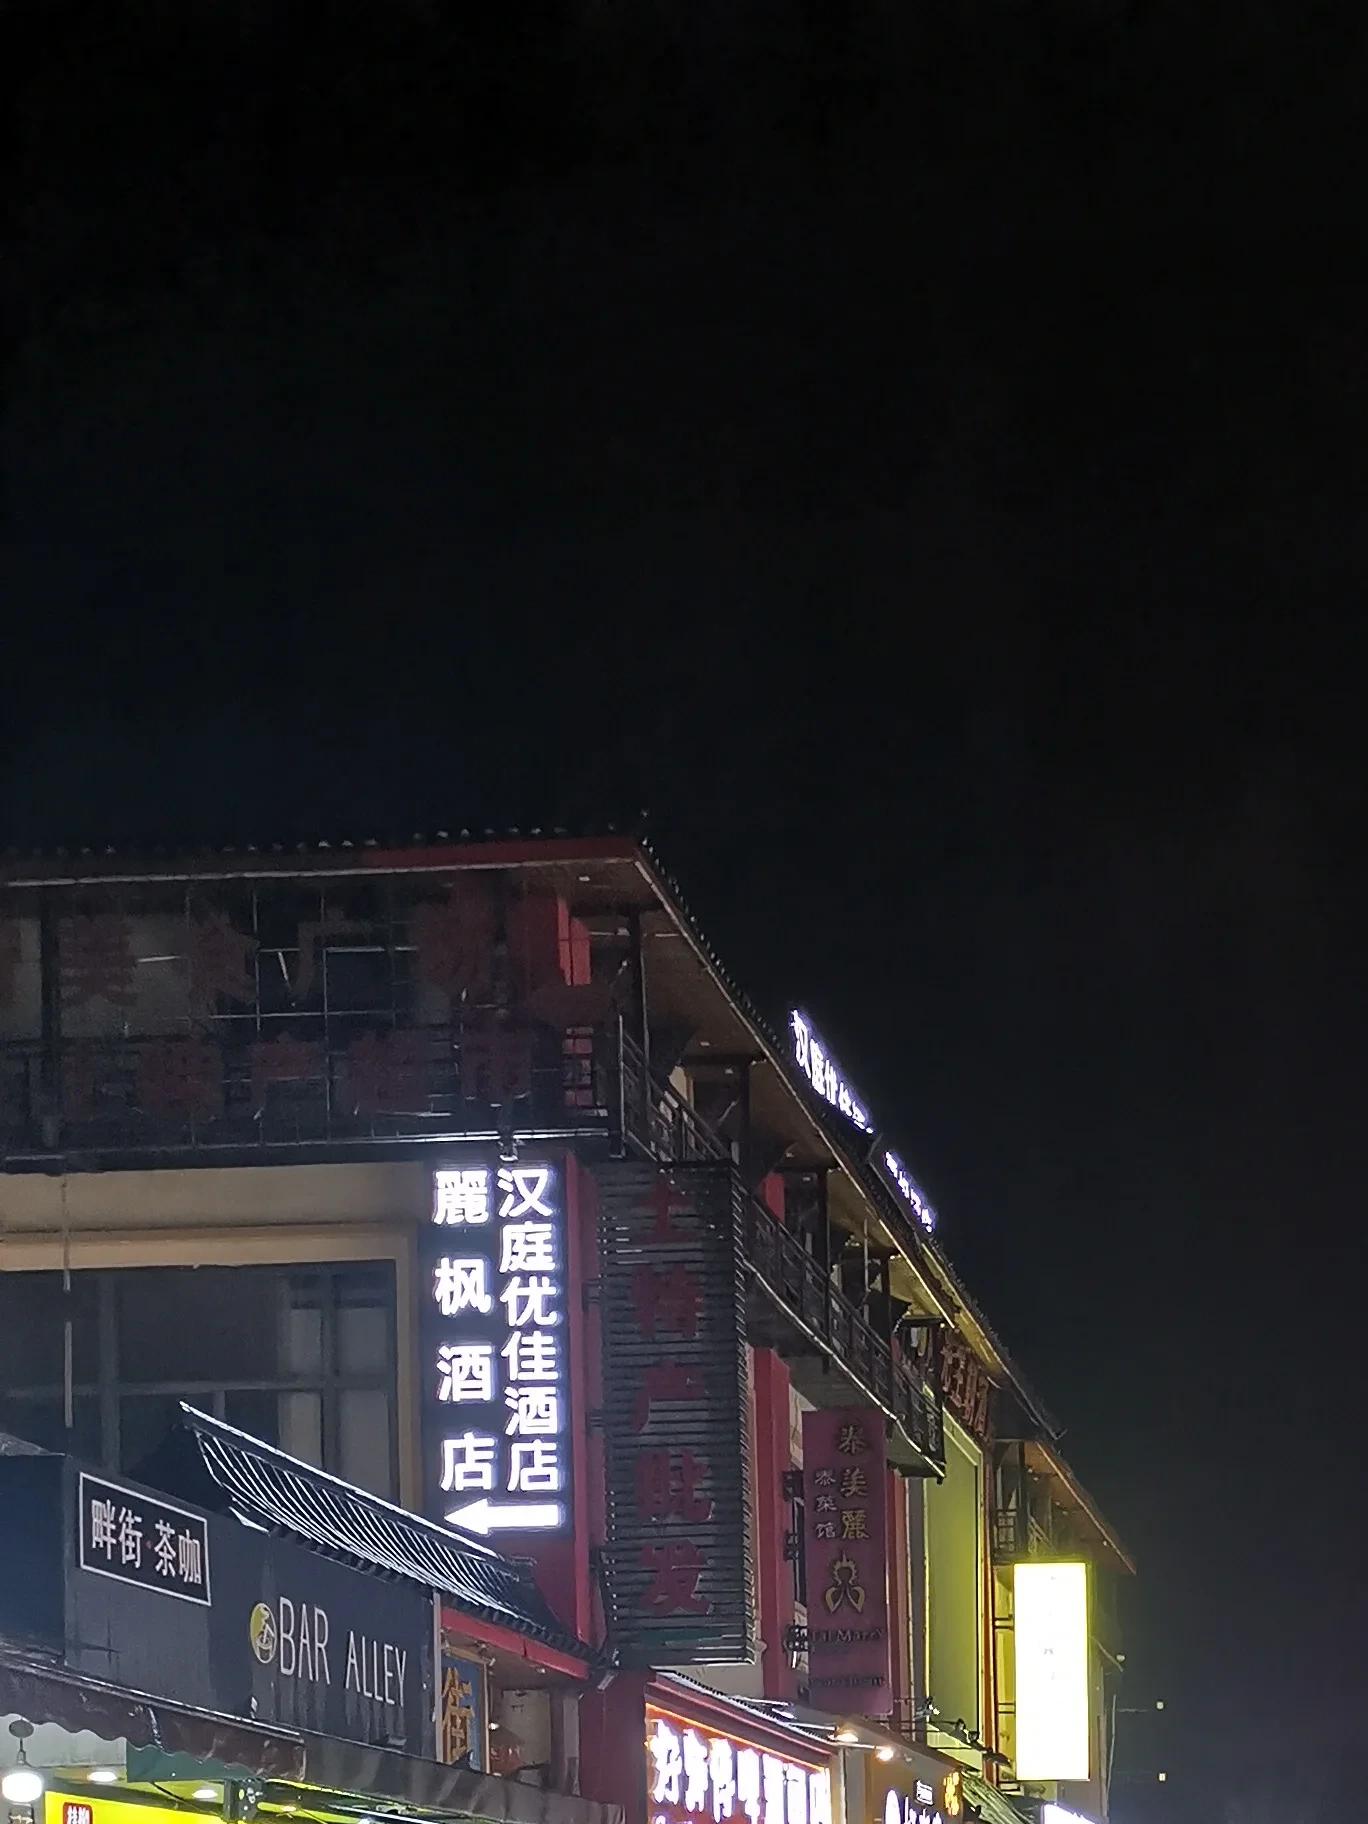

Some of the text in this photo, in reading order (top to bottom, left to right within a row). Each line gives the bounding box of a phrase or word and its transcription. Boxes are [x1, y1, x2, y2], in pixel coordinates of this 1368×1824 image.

[434, 1169, 495, 1492] 麗枫酒店
[498, 1167, 559, 1493] 汉庭优佳酒店
[279, 1596, 407, 1708] BAR ALLEY
